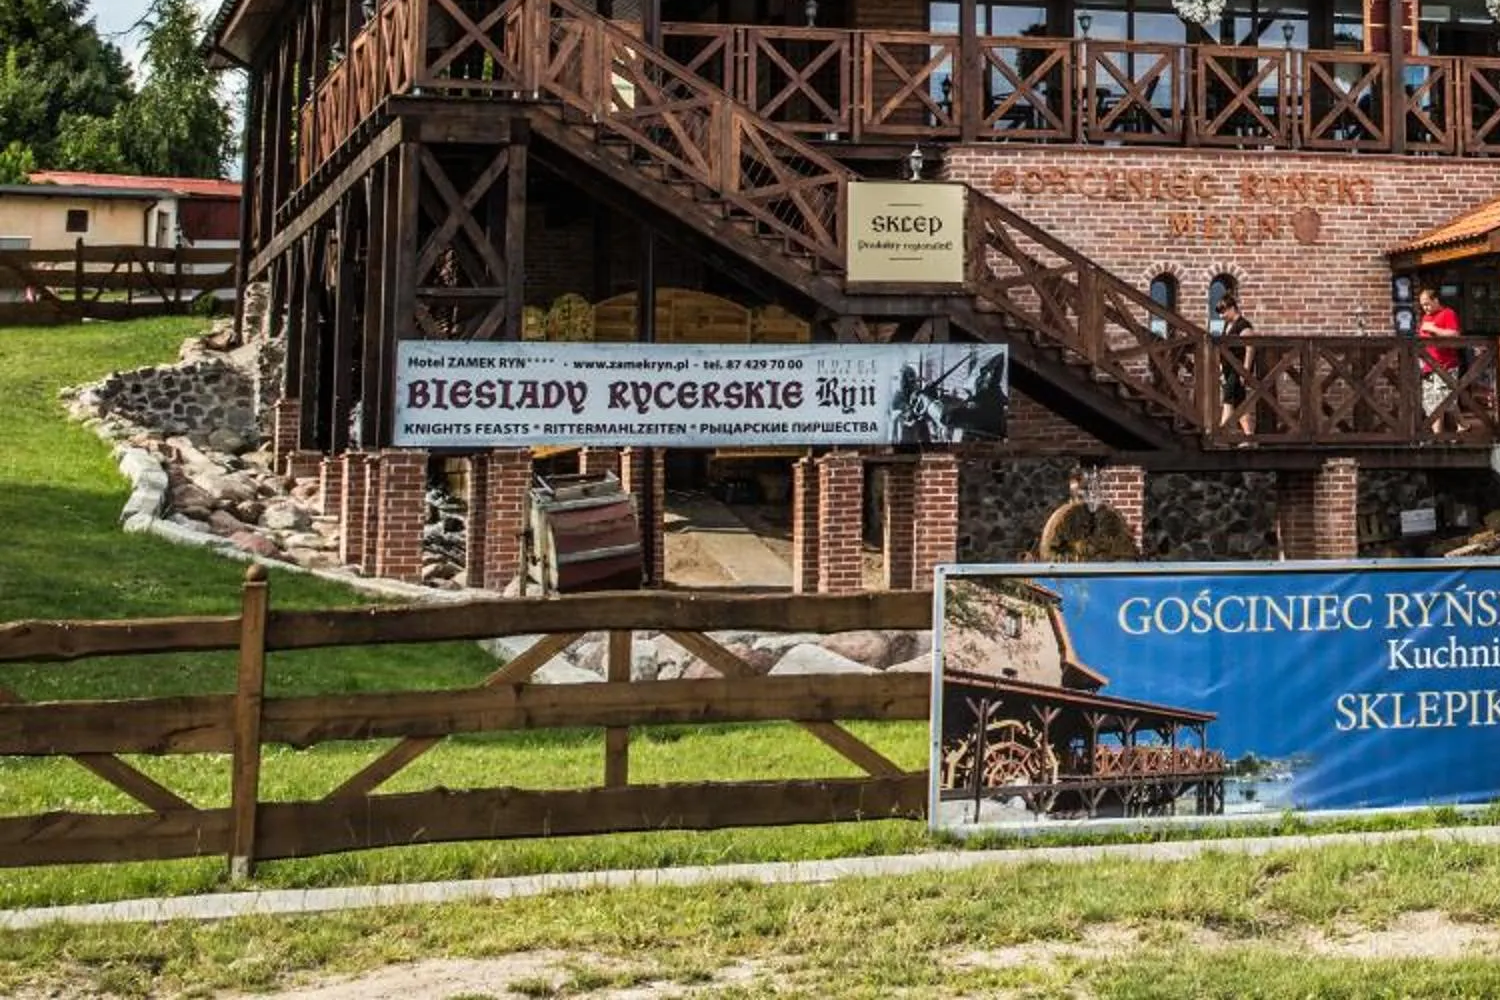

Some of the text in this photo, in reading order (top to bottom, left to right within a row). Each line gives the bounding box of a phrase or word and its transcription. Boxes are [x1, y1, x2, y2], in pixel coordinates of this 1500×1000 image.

[871, 215, 943, 236] SKLEP
[407, 357, 445, 368] Hotel
[448, 357, 496, 368] ZAMEK
[573, 359, 689, 371] www.zamekryn.pl
[703, 359, 723, 370] tel.
[726, 359, 741, 369] 87
[744, 359, 767, 369] 429
[771, 359, 785, 369] 70
[787, 359, 804, 369] 00
[406, 378, 805, 415] BIESIADY RYCERSKIE
[404, 423, 687, 435] KNIGHTS FEASTS RITTERMAHLZEITEN
[700, 421, 878, 435] РЫЦАРСКИЕ ПИРШЕСТВА
[1118, 589, 1373, 635] GOŚCINIEC
